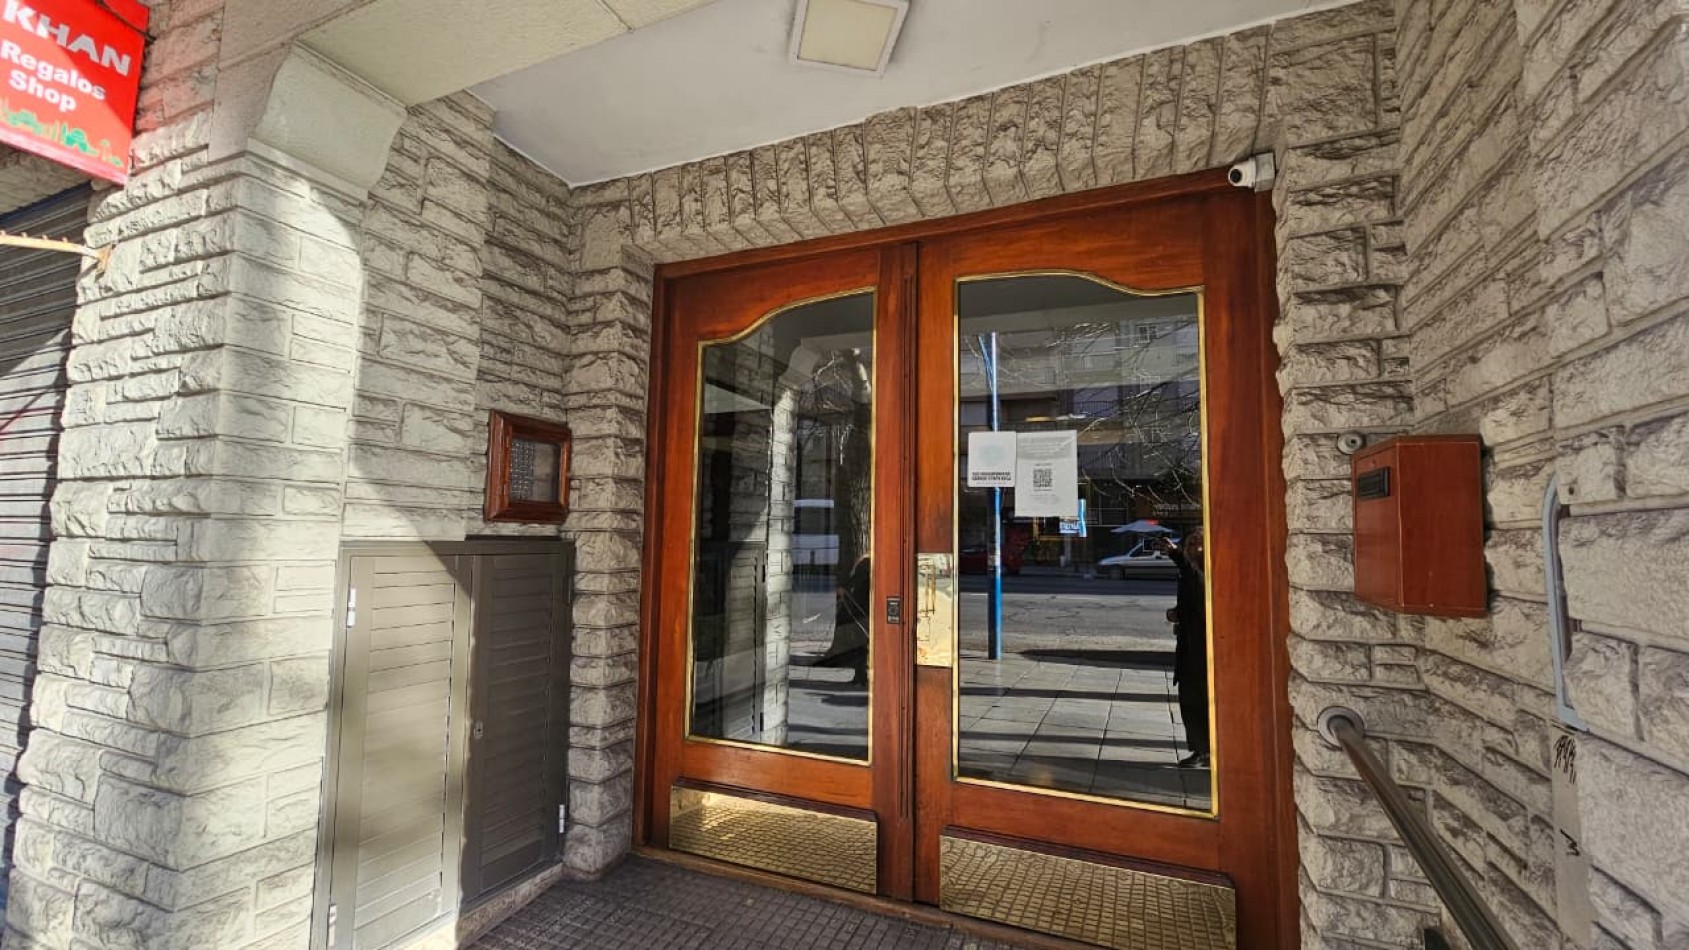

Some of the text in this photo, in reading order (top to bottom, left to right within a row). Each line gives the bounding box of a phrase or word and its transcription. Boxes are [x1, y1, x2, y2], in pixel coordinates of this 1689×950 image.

[3, 0, 131, 76] KHAN
[0, 39, 106, 101] Regalos
[8, 69, 77, 112] Shop
